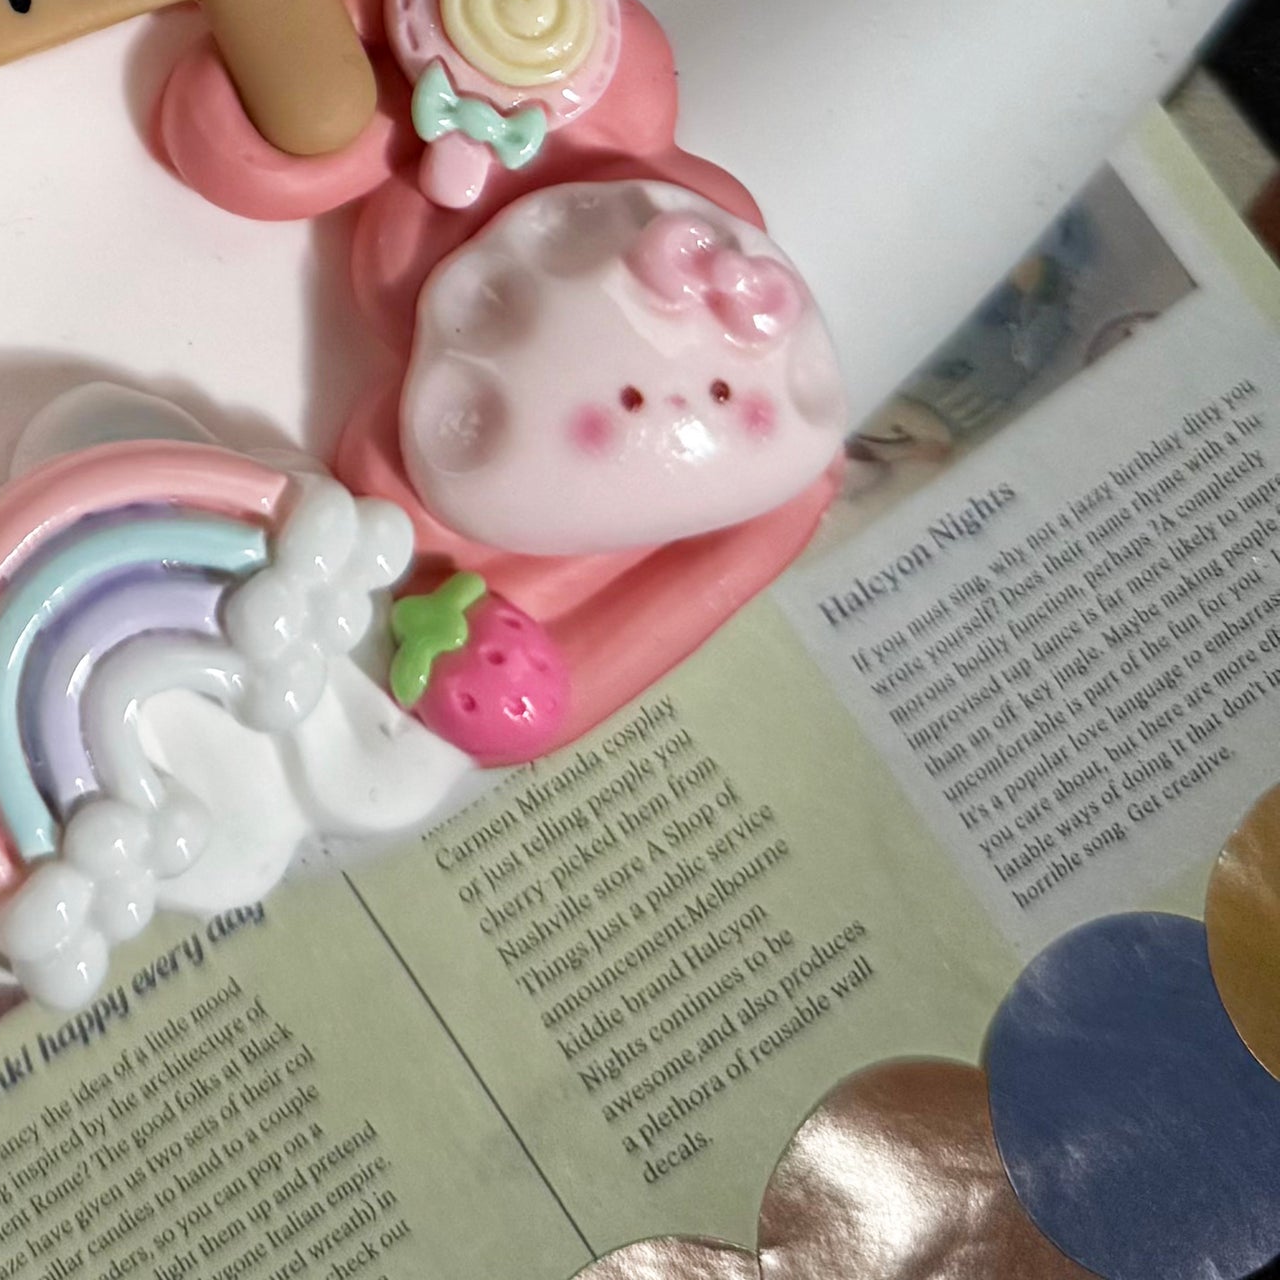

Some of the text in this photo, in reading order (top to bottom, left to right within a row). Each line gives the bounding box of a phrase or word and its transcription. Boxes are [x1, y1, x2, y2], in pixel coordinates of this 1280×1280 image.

[819, 482, 1017, 627] Halcyon Nights
[431, 808, 518, 873] Carmen
[512, 748, 603, 816] Miranda
[600, 695, 681, 757] cosplay
[456, 877, 485, 903] or
[478, 846, 523, 891] just
[518, 804, 591, 858] telling
[584, 756, 654, 818] people
[651, 727, 694, 769] you
[1009, 850, 1083, 907] horrible
[1124, 790, 1162, 824] Get
[1159, 744, 1235, 801] creative.
[31, 986, 135, 1061] happy
[127, 933, 210, 997] every
[39, 1099, 73, 1129] the
[69, 1071, 112, 1107] idea
[110, 1049, 136, 1079] of
[132, 1045, 148, 1064] a
[143, 1015, 191, 1054] little
[188, 973, 242, 1024] mood
[555, 900, 767, 1059] kiddie brand Halcyon
[620, 953, 874, 1153] a plethora of reusable wall
[637, 1130, 713, 1185] decals.
